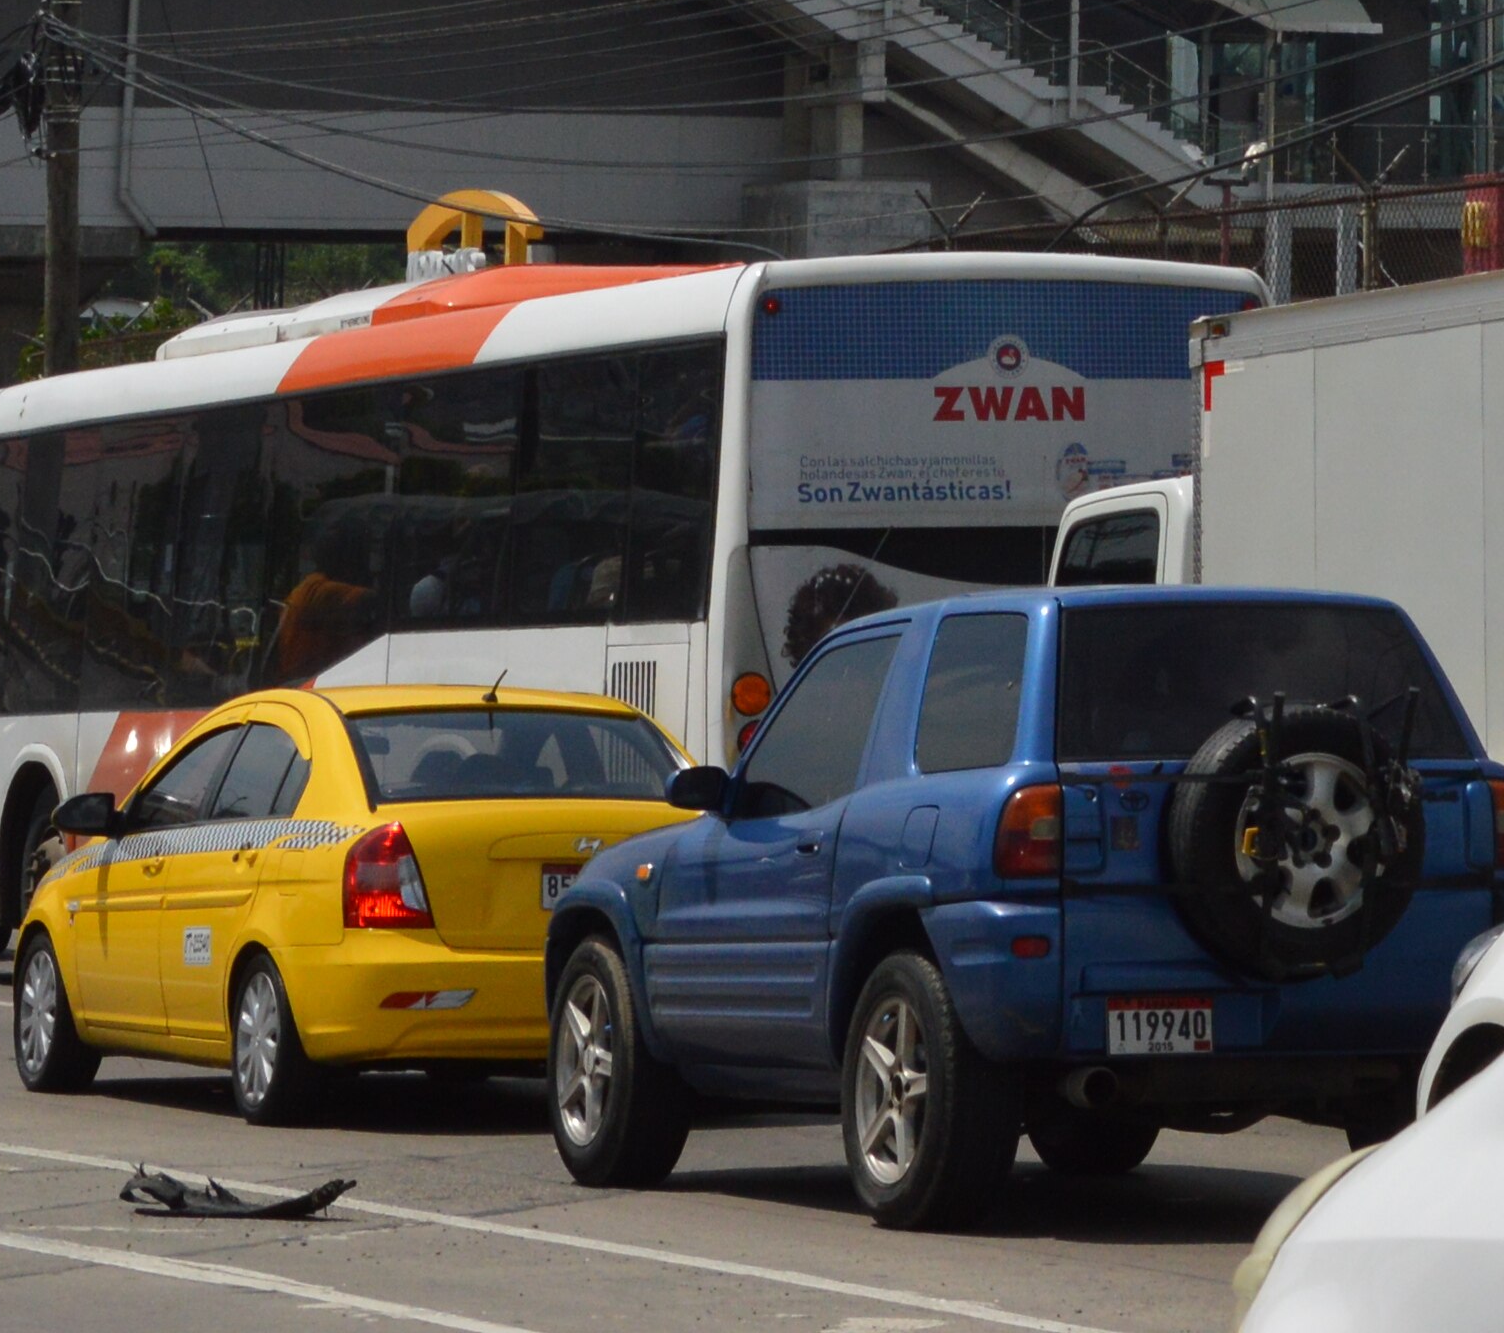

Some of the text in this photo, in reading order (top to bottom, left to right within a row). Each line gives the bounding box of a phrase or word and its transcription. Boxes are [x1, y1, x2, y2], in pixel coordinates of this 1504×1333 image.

[932, 386, 1086, 422] ZWAN
[798, 479, 1012, 503] Son Zwantásticas!
[1117, 1010, 1207, 1042] 119940
[1147, 1041, 1175, 1053] 2015
